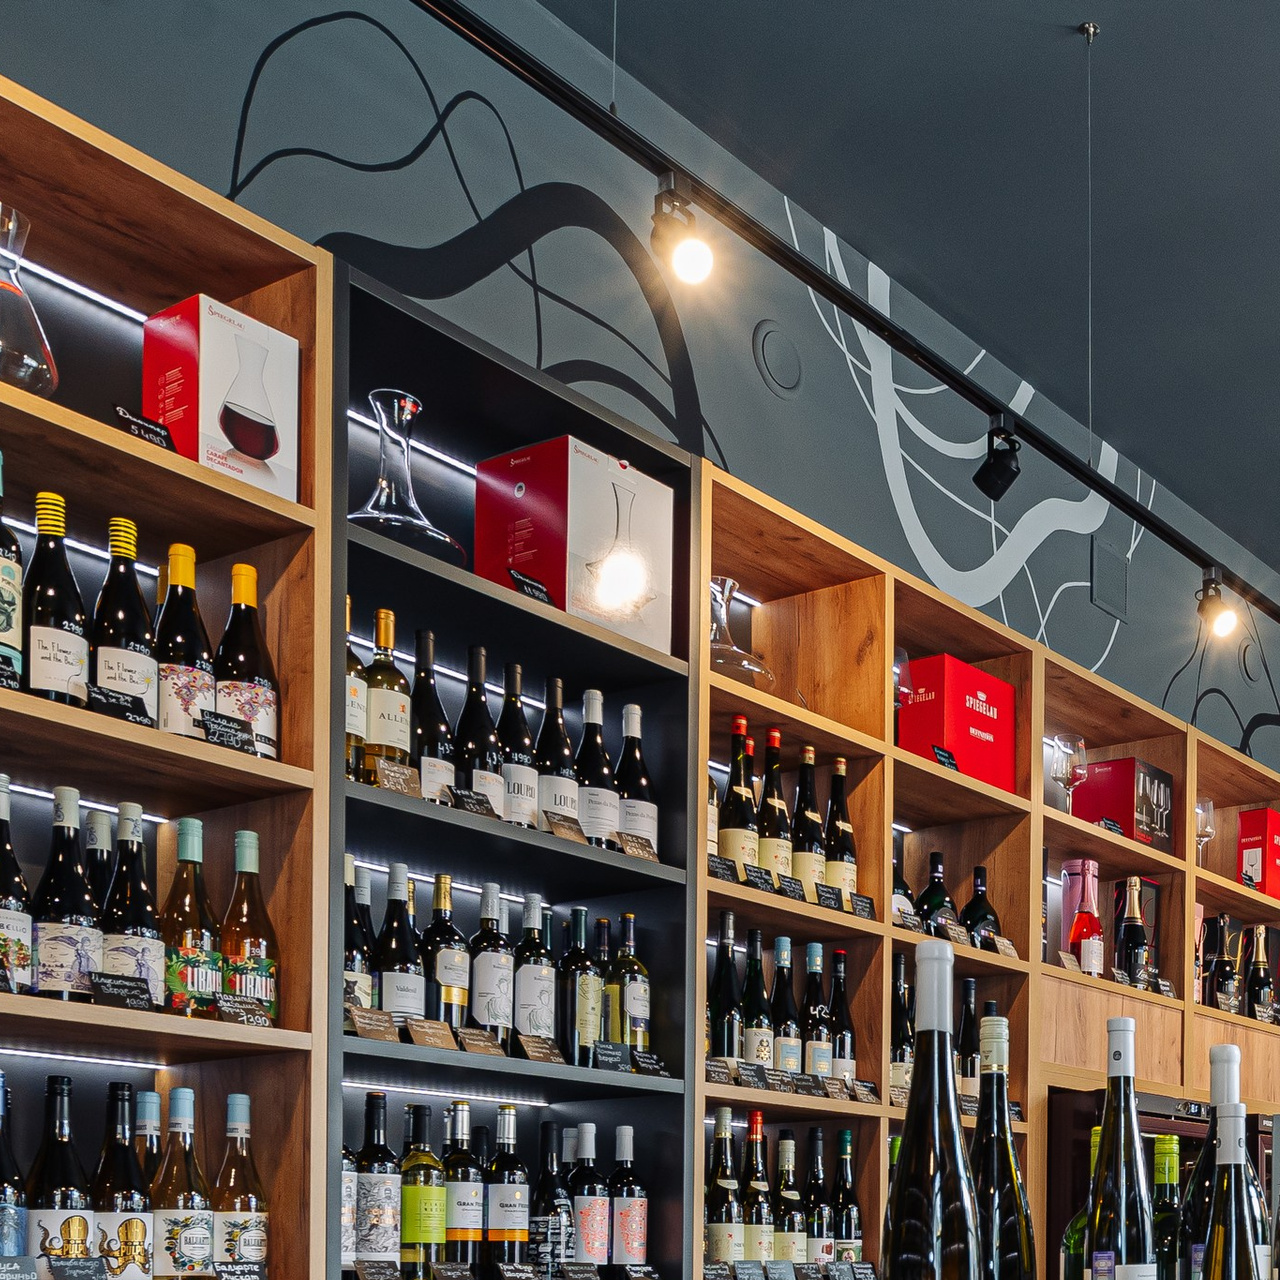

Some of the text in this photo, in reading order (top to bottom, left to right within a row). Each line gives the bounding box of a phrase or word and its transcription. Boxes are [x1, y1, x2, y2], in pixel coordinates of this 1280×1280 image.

[207, 304, 246, 330] SPIEGELAU
[206, 449, 228, 461] CARAFE
[206, 455, 244, 475] DECANTADOR
[62, 620, 84, 636] 2790
[37, 639, 72, 656] The Flower
[127, 641, 151, 657] 2790
[41, 651, 52, 661] and
[52, 652, 62, 663] the
[104, 660, 137, 675] The Flower
[106, 672, 117, 682] and
[118, 672, 127, 682] the
[965, 694, 998, 720] SPIEGELAU
[126, 712, 151, 726] 2790
[208, 730, 241, 748] 2790
[507, 781, 536, 799] LOURO
[126, 998, 149, 1009] 1990
[238, 1014, 270, 1027] 1390
[214, 1263, 260, 1274] Балуарте
